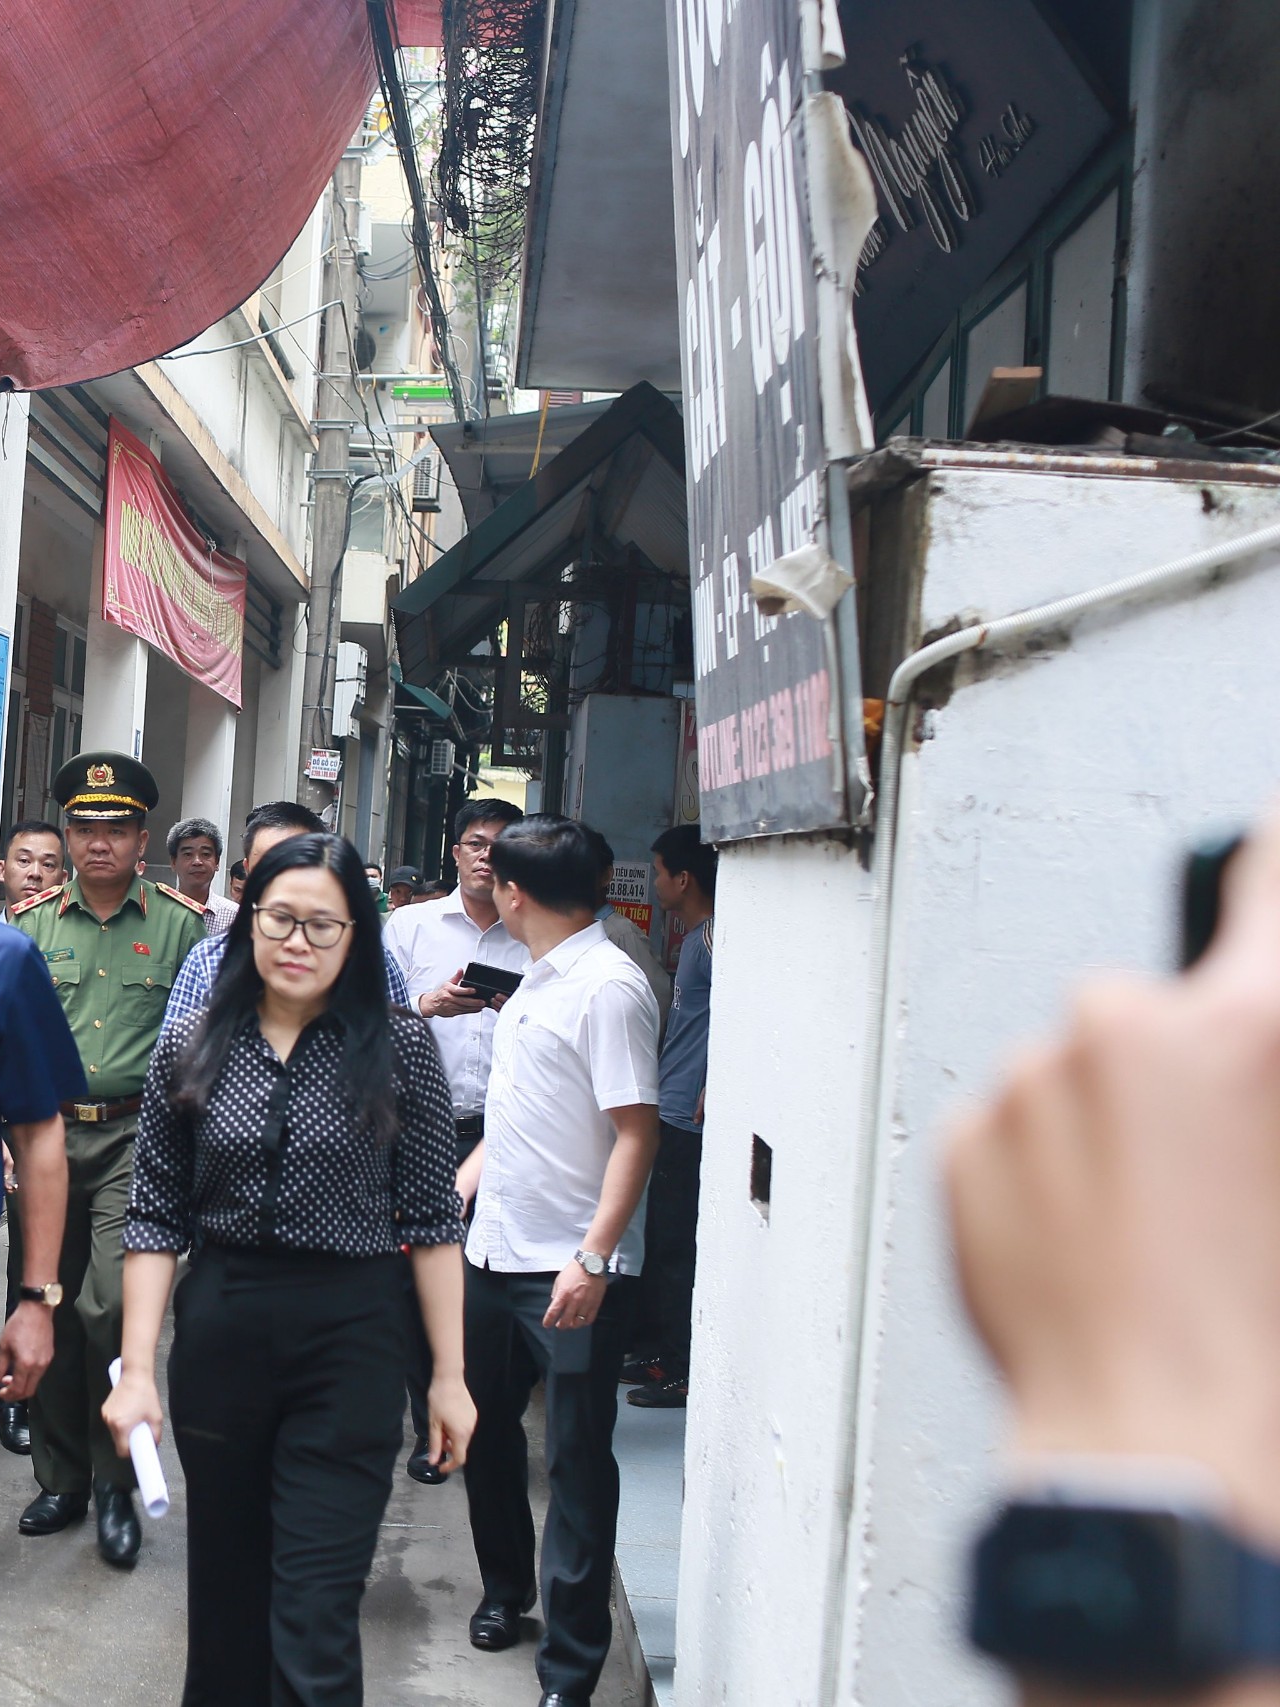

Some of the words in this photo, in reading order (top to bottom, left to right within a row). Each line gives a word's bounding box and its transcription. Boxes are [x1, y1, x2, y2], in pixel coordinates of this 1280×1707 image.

[615, 867, 628, 877] TIÊU
[628, 867, 646, 879] DÙNG
[629, 904, 649, 921] TIỀN
